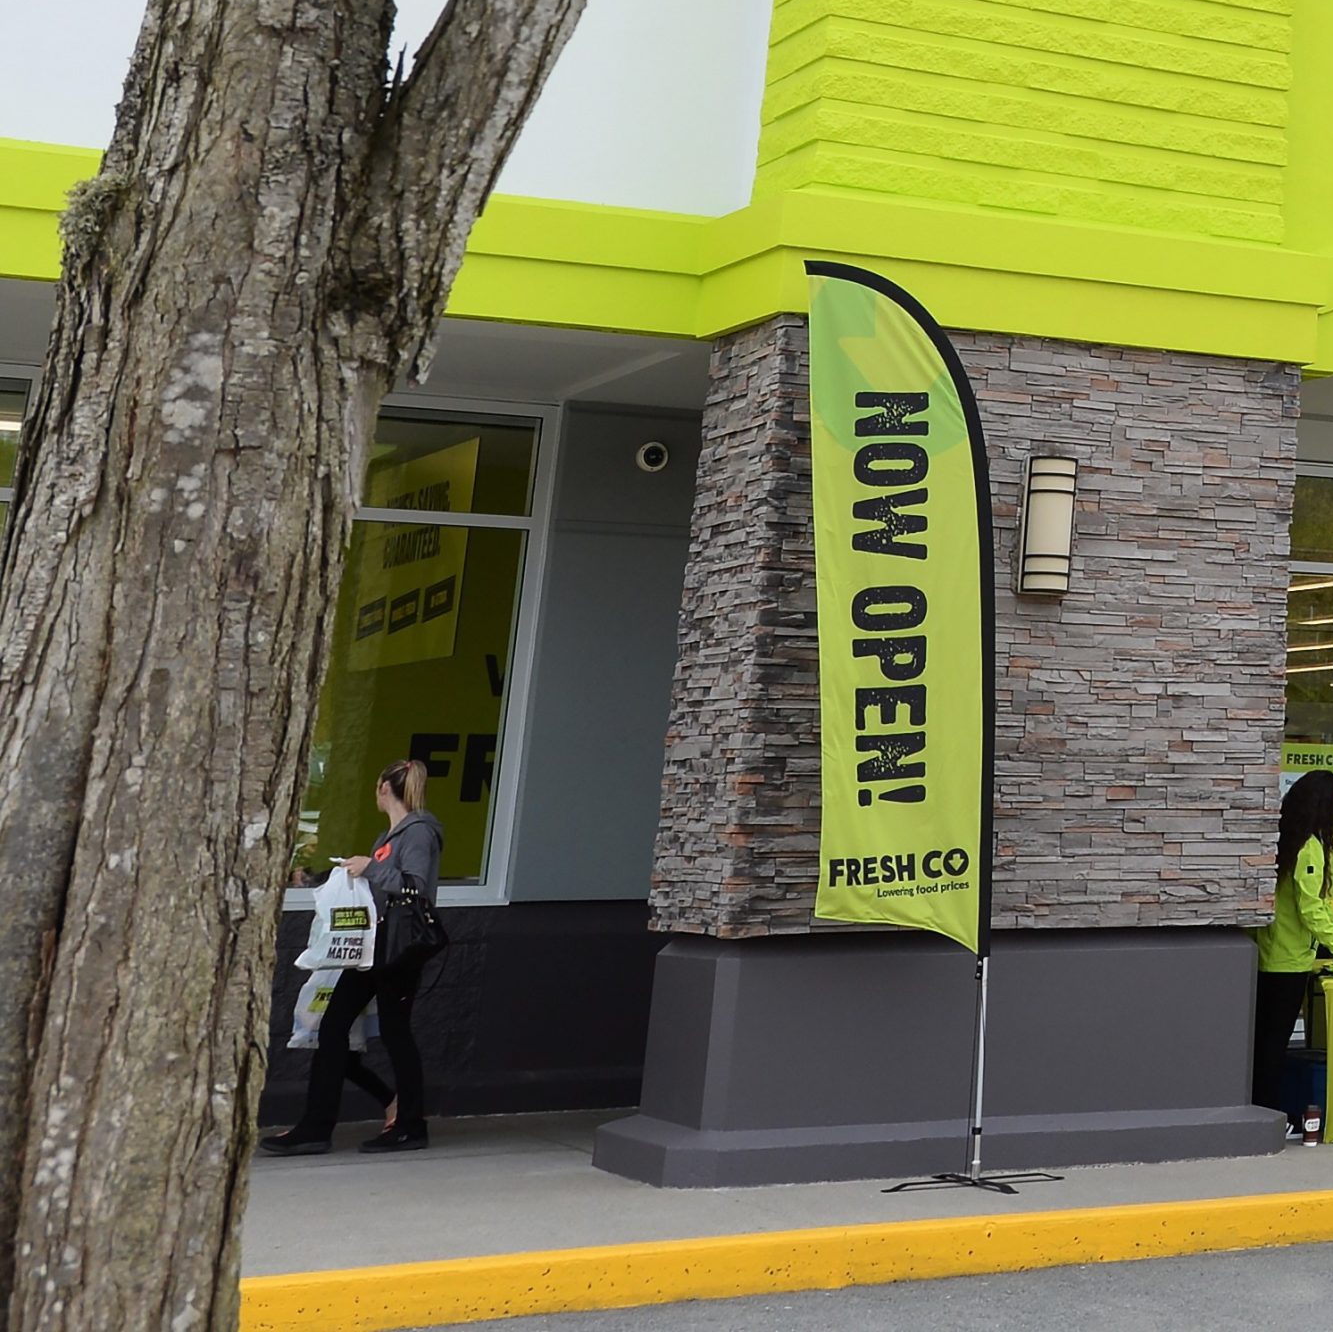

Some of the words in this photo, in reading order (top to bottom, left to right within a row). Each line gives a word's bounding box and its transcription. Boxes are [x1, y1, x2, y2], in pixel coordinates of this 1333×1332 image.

[852, 391, 930, 561] NOW
[851, 585, 928, 807] OPEN!
[1286, 753, 1324, 765] FRESH
[829, 853, 916, 887] FRESH
[922, 848, 969, 879] CO
[877, 886, 914, 898] Lowering
[916, 883, 939, 894] food
[940, 881, 969, 894] prices
[327, 947, 363, 960] MATCH
